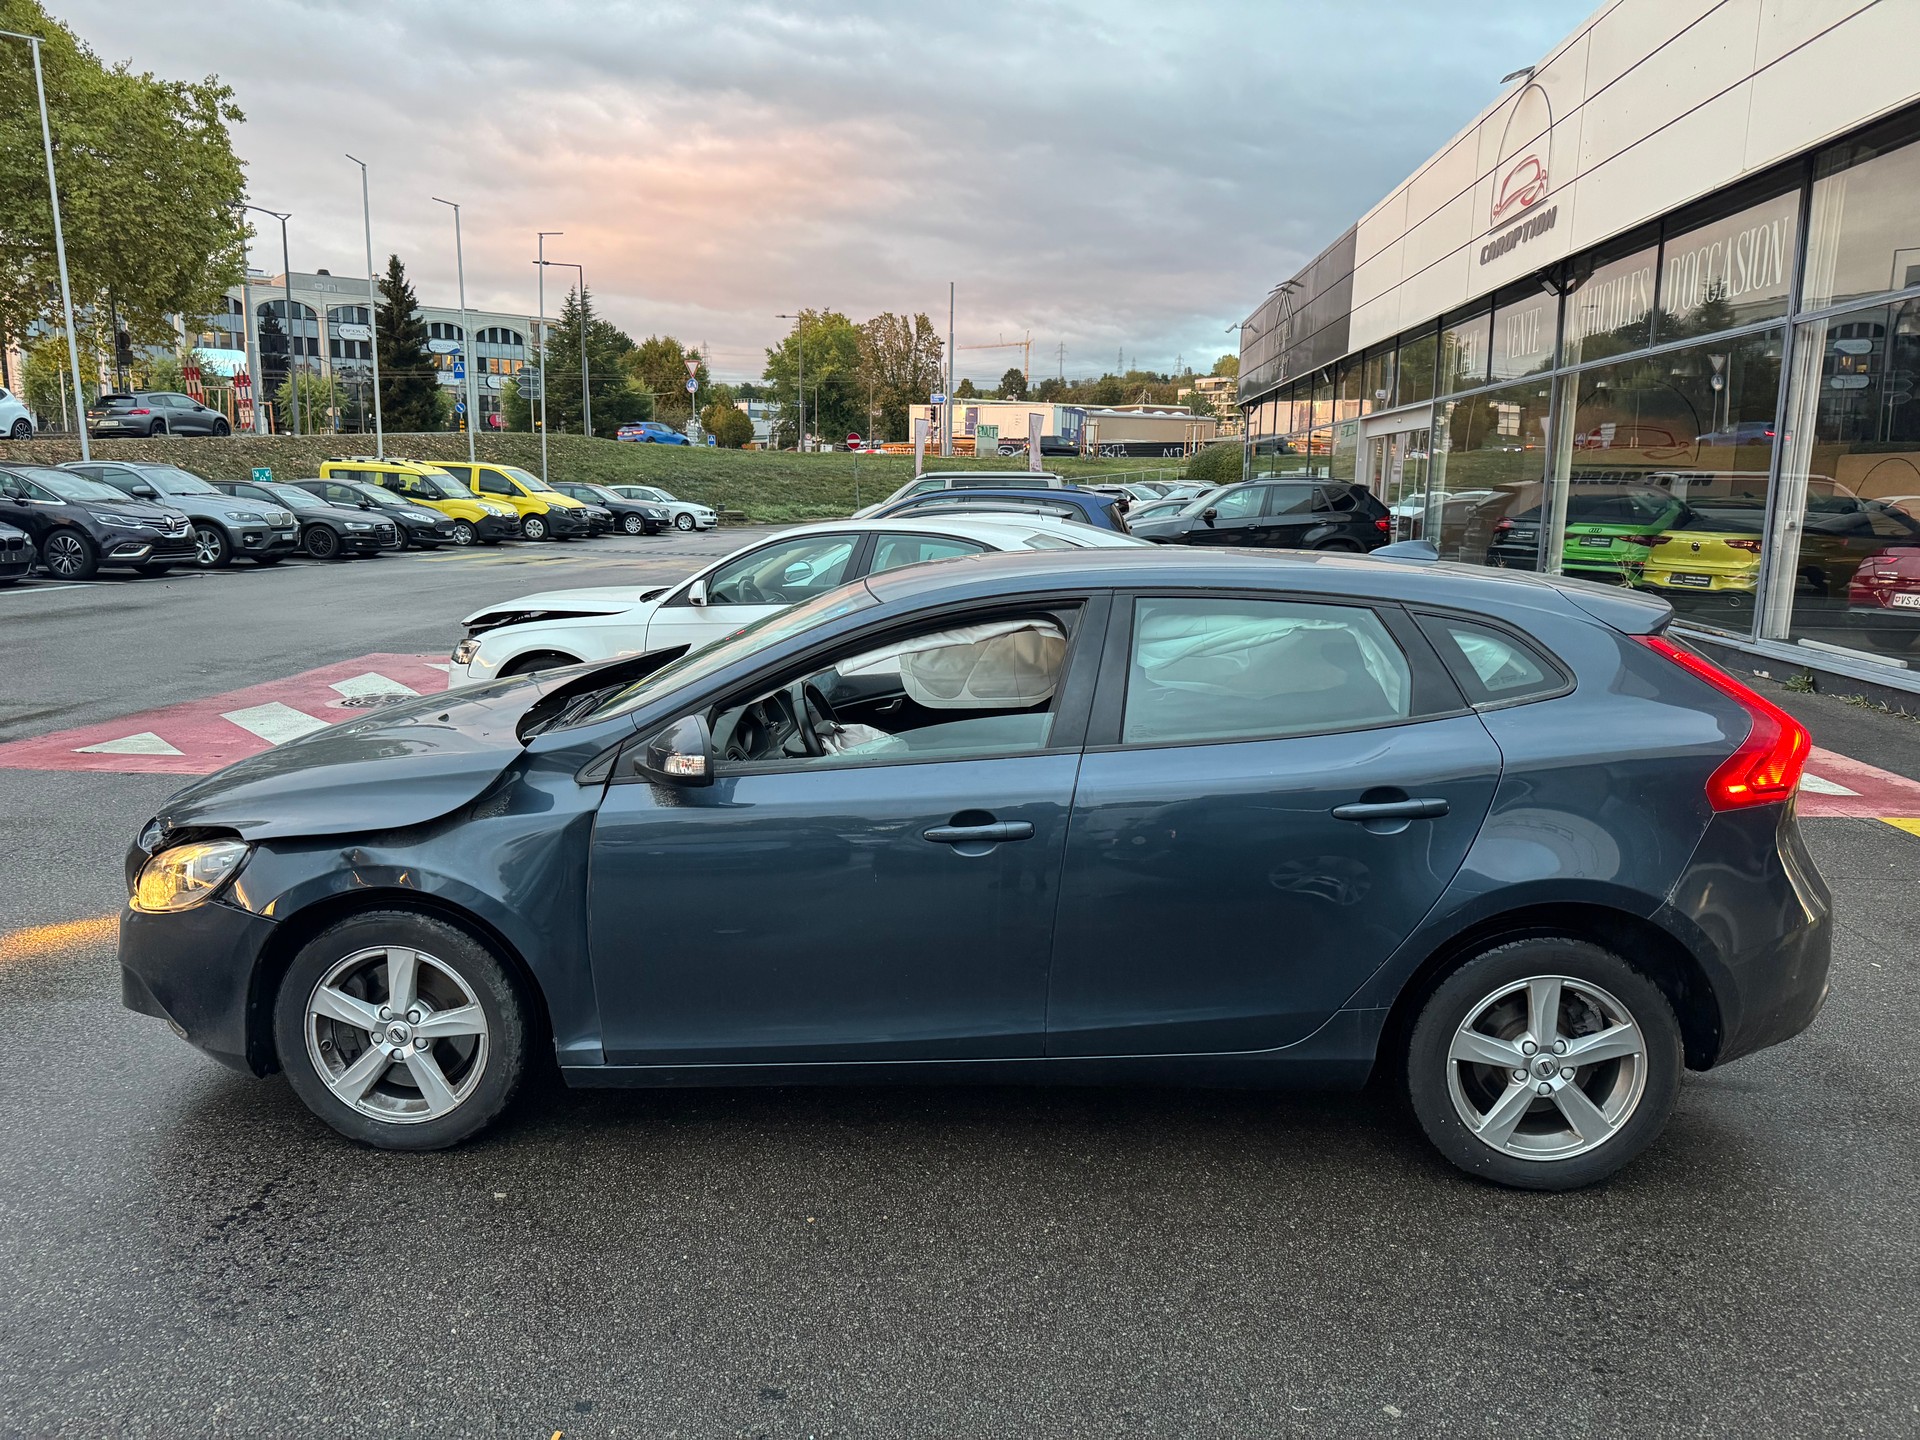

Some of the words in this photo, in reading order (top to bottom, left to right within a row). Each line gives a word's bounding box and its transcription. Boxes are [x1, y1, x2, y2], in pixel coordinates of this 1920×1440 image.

[1480, 205, 1557, 266] CAROPTION
[1506, 307, 1542, 359] VENTE
[1665, 216, 1789, 315] D'OCCASION
